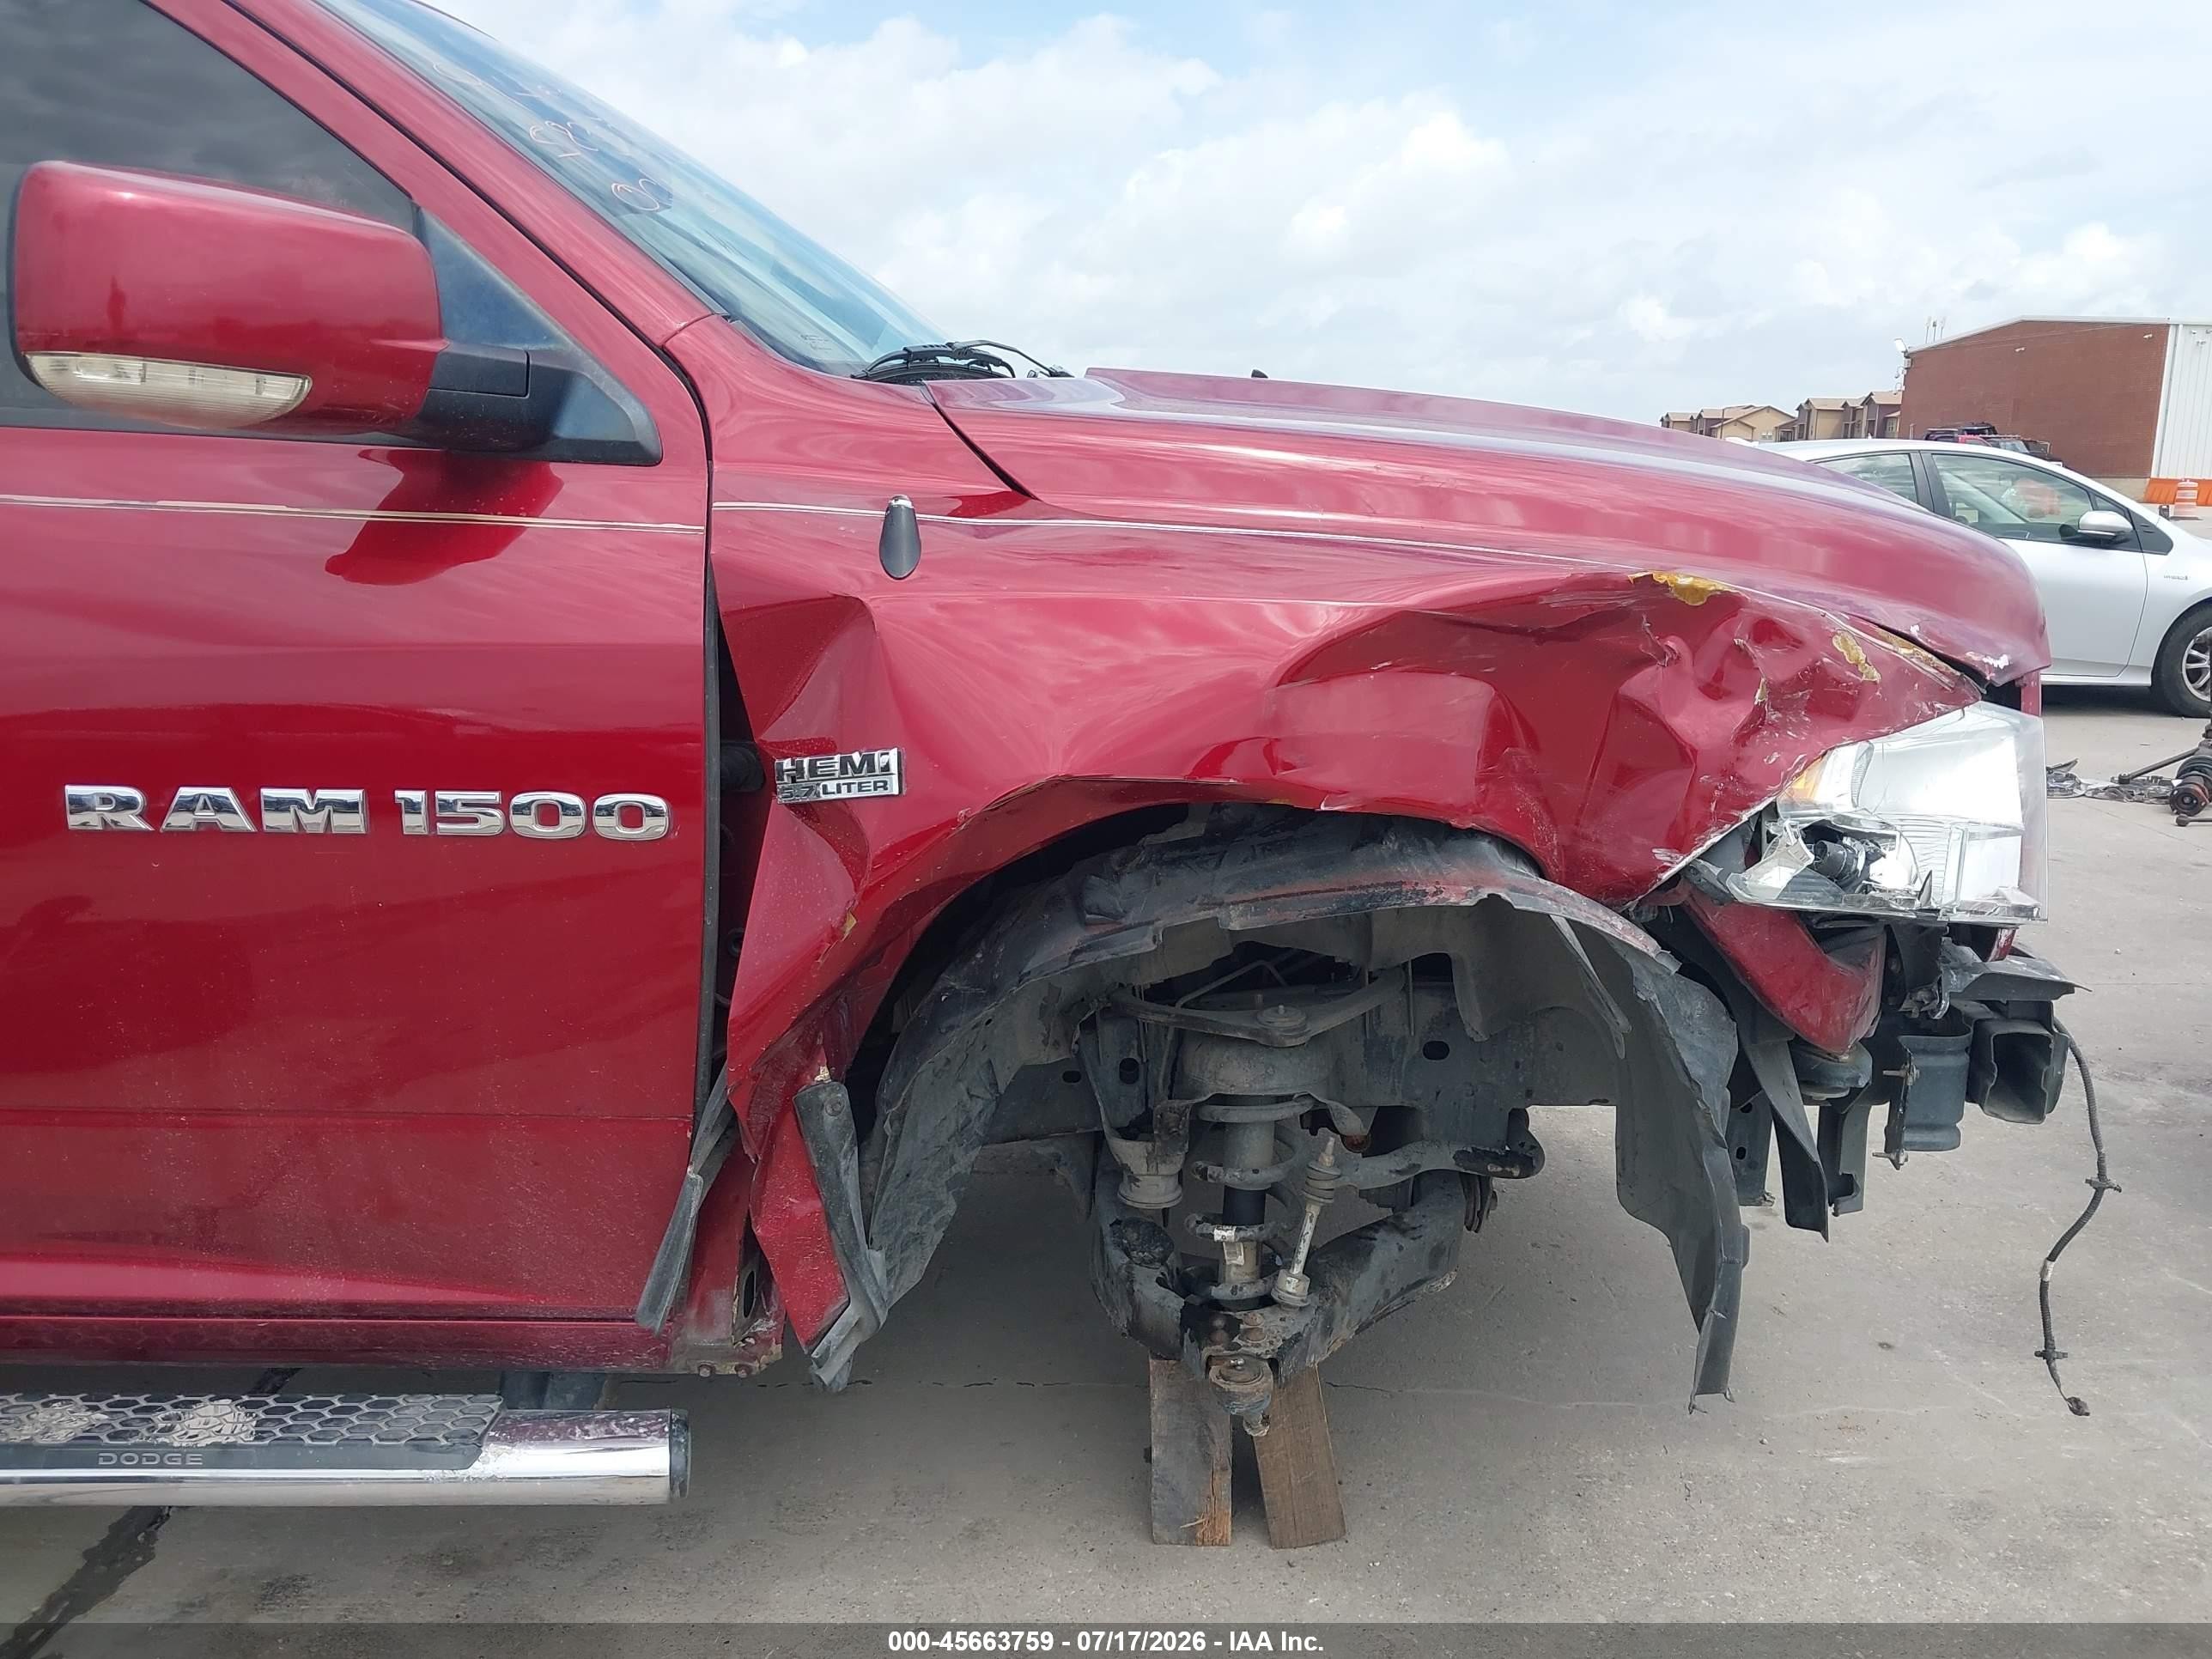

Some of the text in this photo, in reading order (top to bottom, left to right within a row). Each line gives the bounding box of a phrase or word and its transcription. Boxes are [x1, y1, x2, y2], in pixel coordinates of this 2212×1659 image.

[775, 750, 891, 782] HEMI
[821, 779, 889, 796] LITER
[64, 784, 671, 840] RAM 1500
[98, 1452, 204, 1465] DODGE
